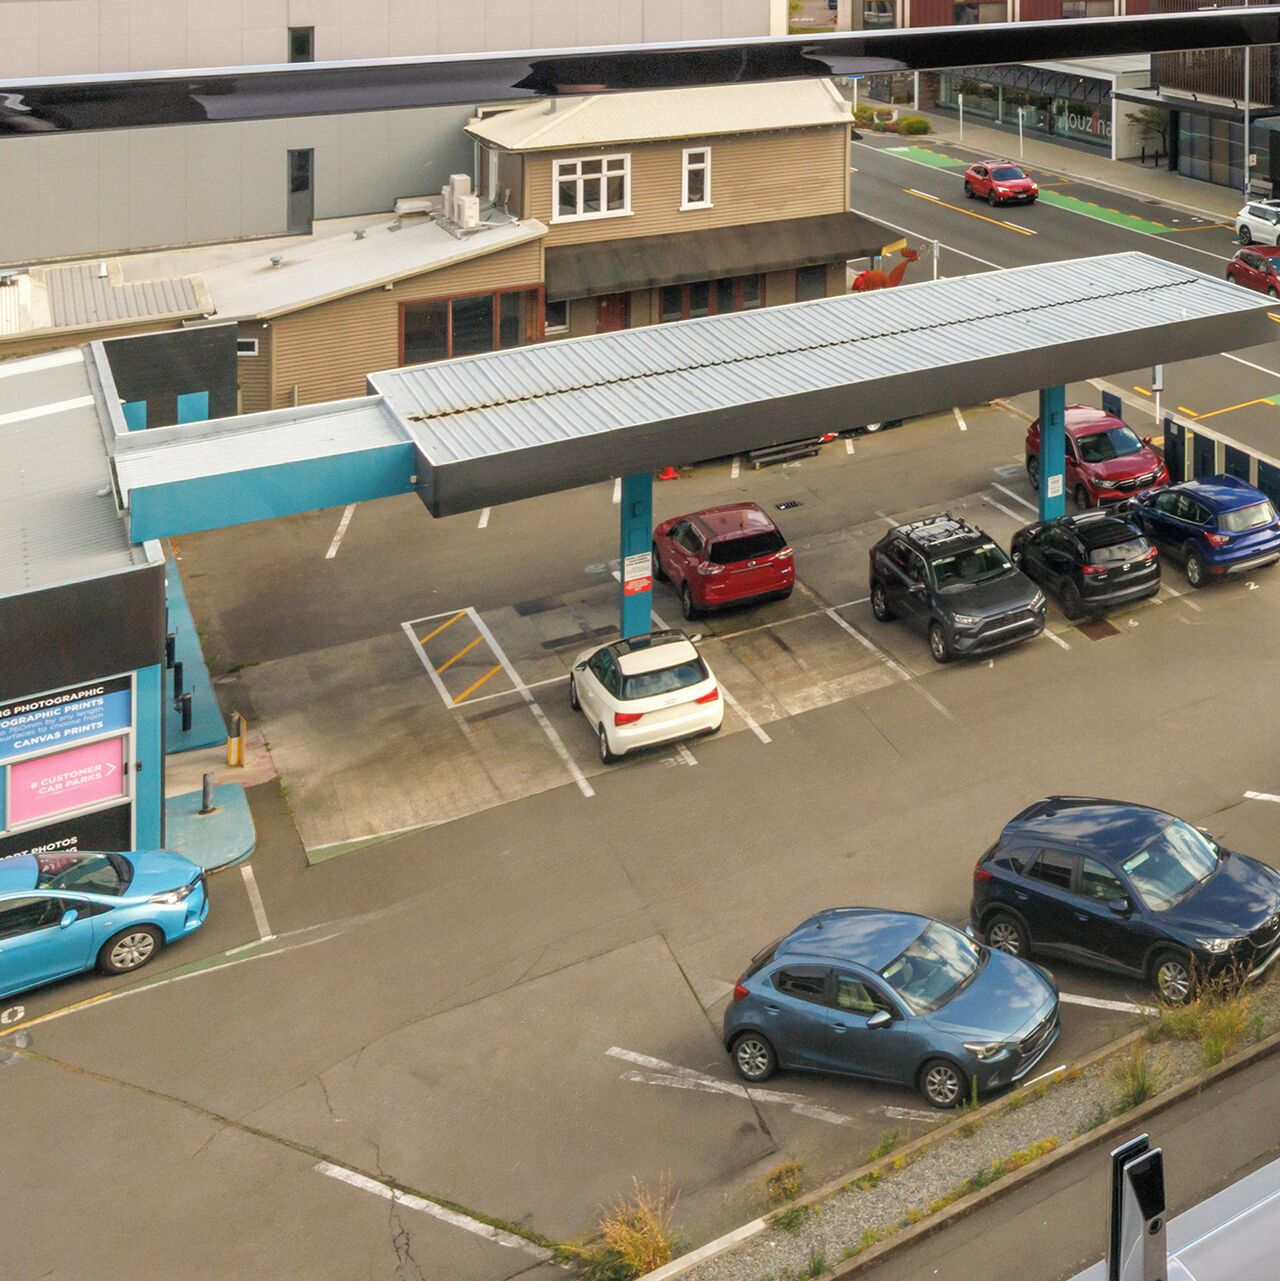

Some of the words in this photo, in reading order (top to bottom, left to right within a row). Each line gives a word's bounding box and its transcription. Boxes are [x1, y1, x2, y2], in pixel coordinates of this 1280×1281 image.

[1244, 581, 1260, 590] 2
[14, 686, 104, 714] PHOTOGRAPHIC
[0, 708, 62, 729] OGRAPHIC
[64, 697, 104, 713] PRINTS
[45, 716, 55, 726] by
[60, 713, 75, 722] any
[76, 707, 104, 719] length
[49, 719, 81, 730] choose
[83, 713, 104, 722] from
[13, 732, 61, 749] CANVAS
[63, 721, 104, 737] PRINTS
[39, 783, 62, 795] CAR
[65, 772, 102, 787] PARKS
[40, 764, 102, 786] CUSTOMER
[31, 836, 78, 854] PHOTOS
